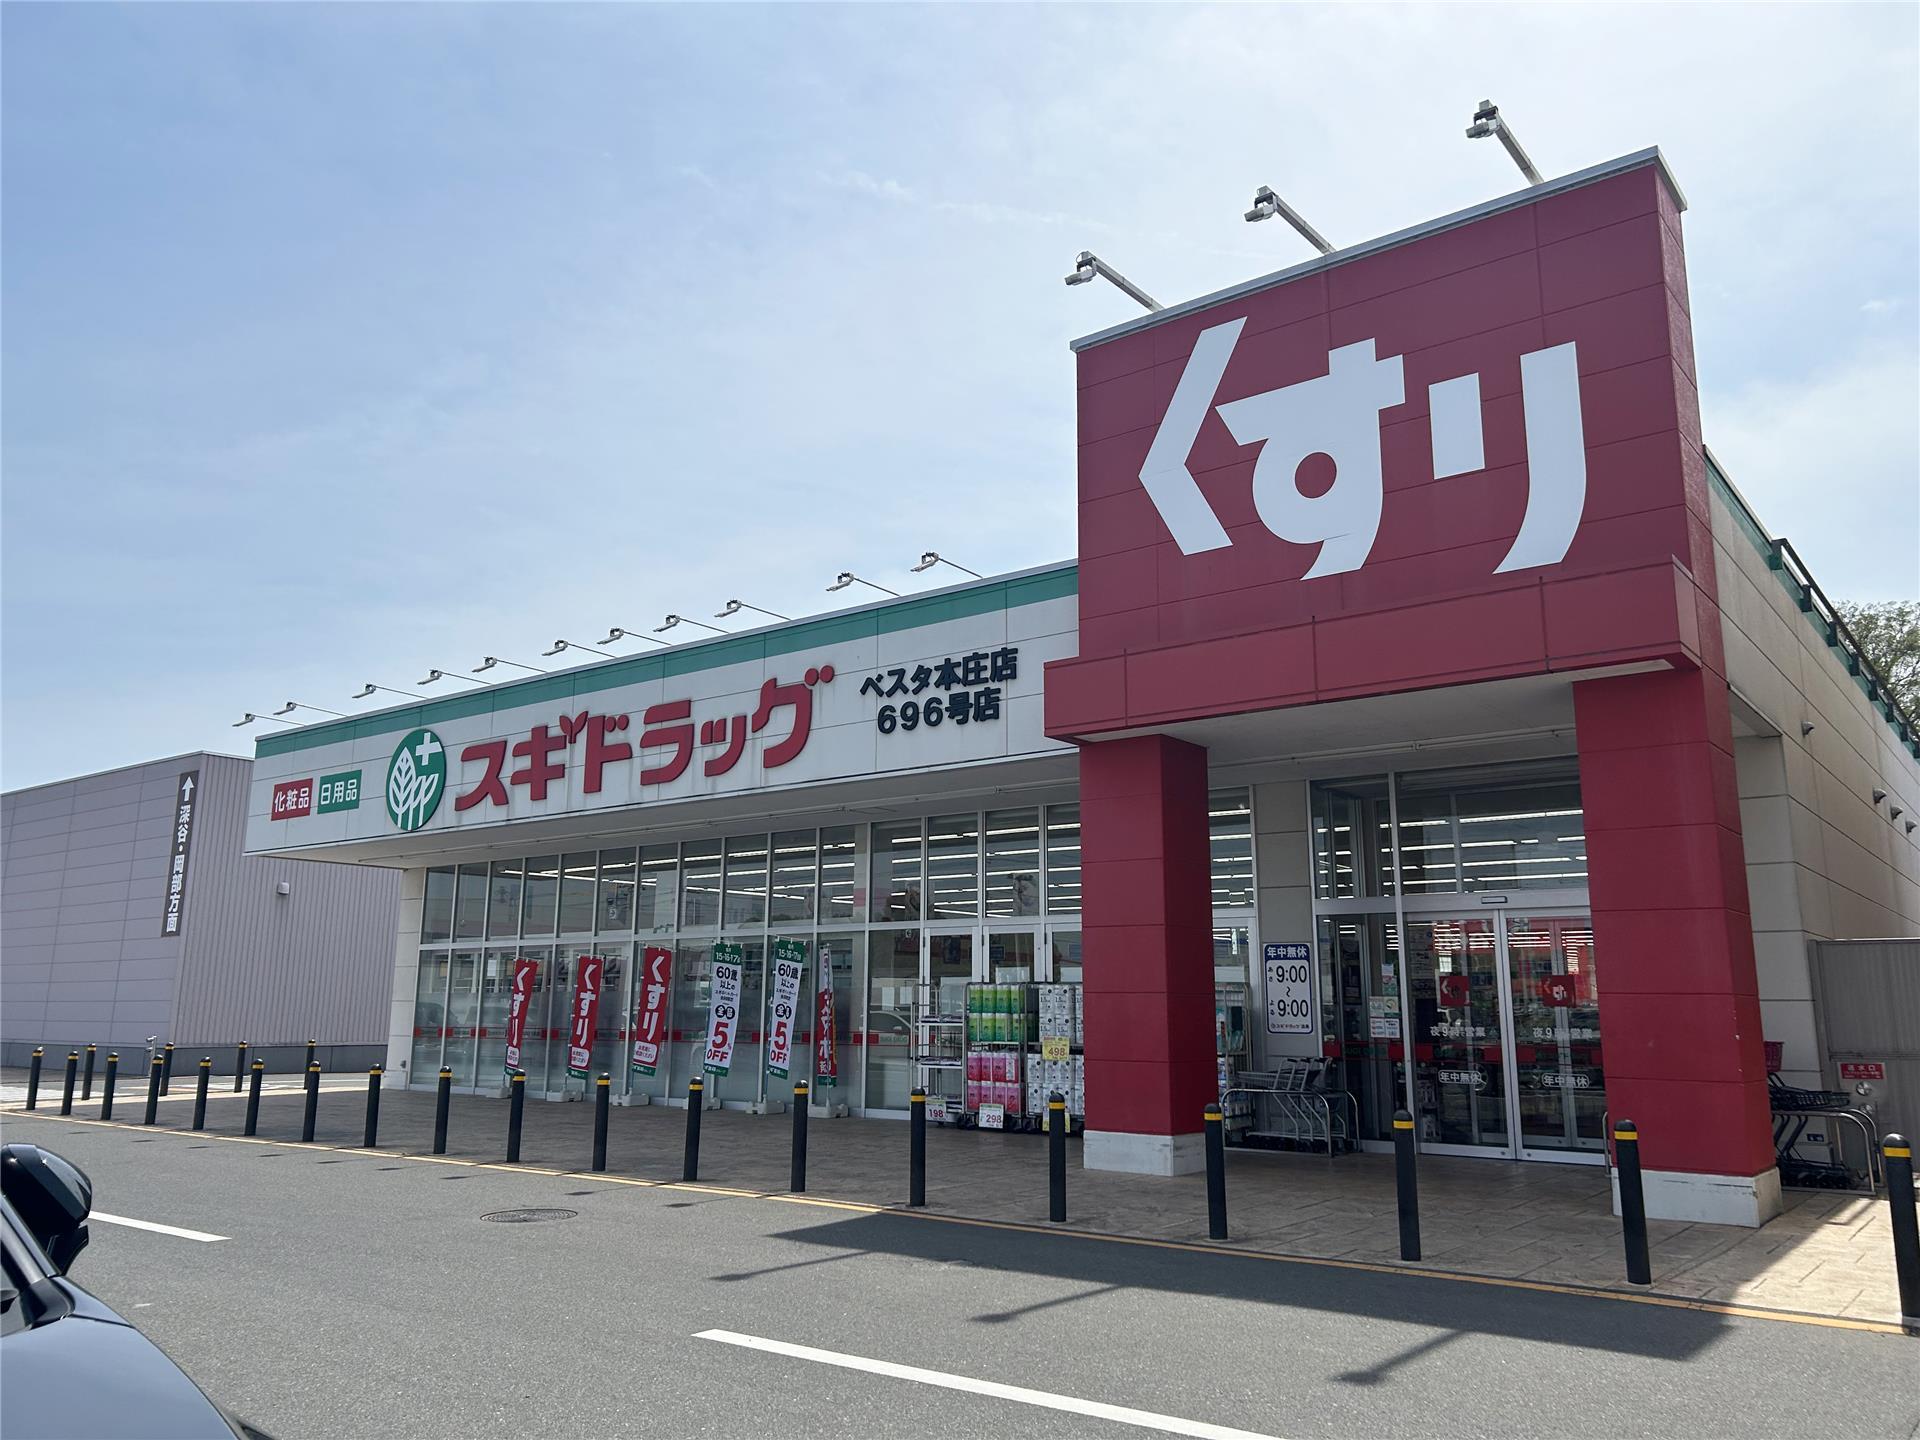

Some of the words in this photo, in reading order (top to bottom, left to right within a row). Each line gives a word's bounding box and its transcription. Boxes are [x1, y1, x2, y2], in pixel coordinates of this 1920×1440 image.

[1138, 315, 1588, 582] くすり
[859, 646, 1019, 698] ベスタ本庄店
[877, 686, 1002, 734] 696号店
[454, 664, 835, 812] スギドラッグ
[274, 786, 310, 813] 化粧品
[320, 778, 358, 805] 日用品
[1267, 946, 1307, 958] 年中無休
[1276, 965, 1307, 983] 9:00
[511, 966, 530, 1047] くすり
[575, 964, 598, 1047] くすり
[645, 955, 666, 1042] くすり
[1277, 999, 1309, 1018] 9:00
[706, 1049, 728, 1062] OFF
[1048, 1047, 1066, 1056] 498
[928, 1108, 944, 1118] 198
[986, 1114, 1002, 1123] 298
